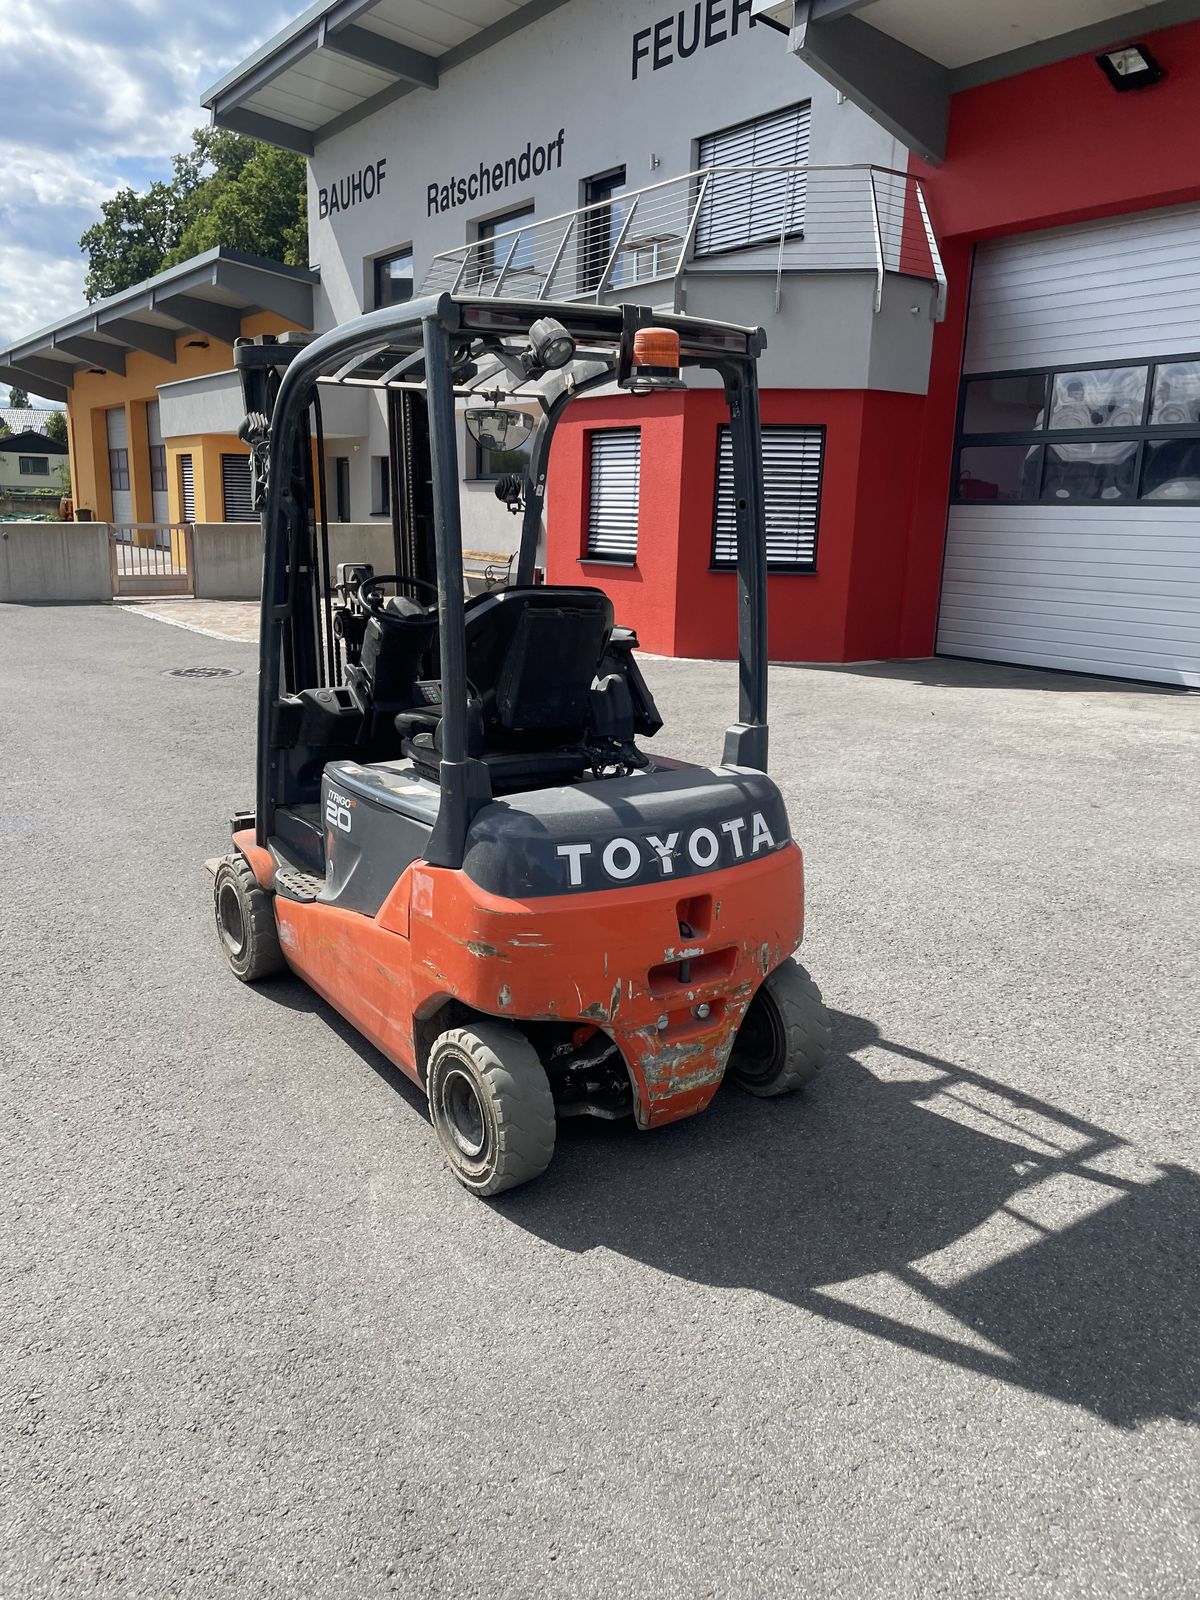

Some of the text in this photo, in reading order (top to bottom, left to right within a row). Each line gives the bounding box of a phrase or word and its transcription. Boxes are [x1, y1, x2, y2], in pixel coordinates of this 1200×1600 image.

[318, 158, 387, 220] BAUHOF
[427, 128, 565, 217] Ratschendorf
[326, 799, 352, 833] 20
[556, 812, 775, 886] TOYOTA
